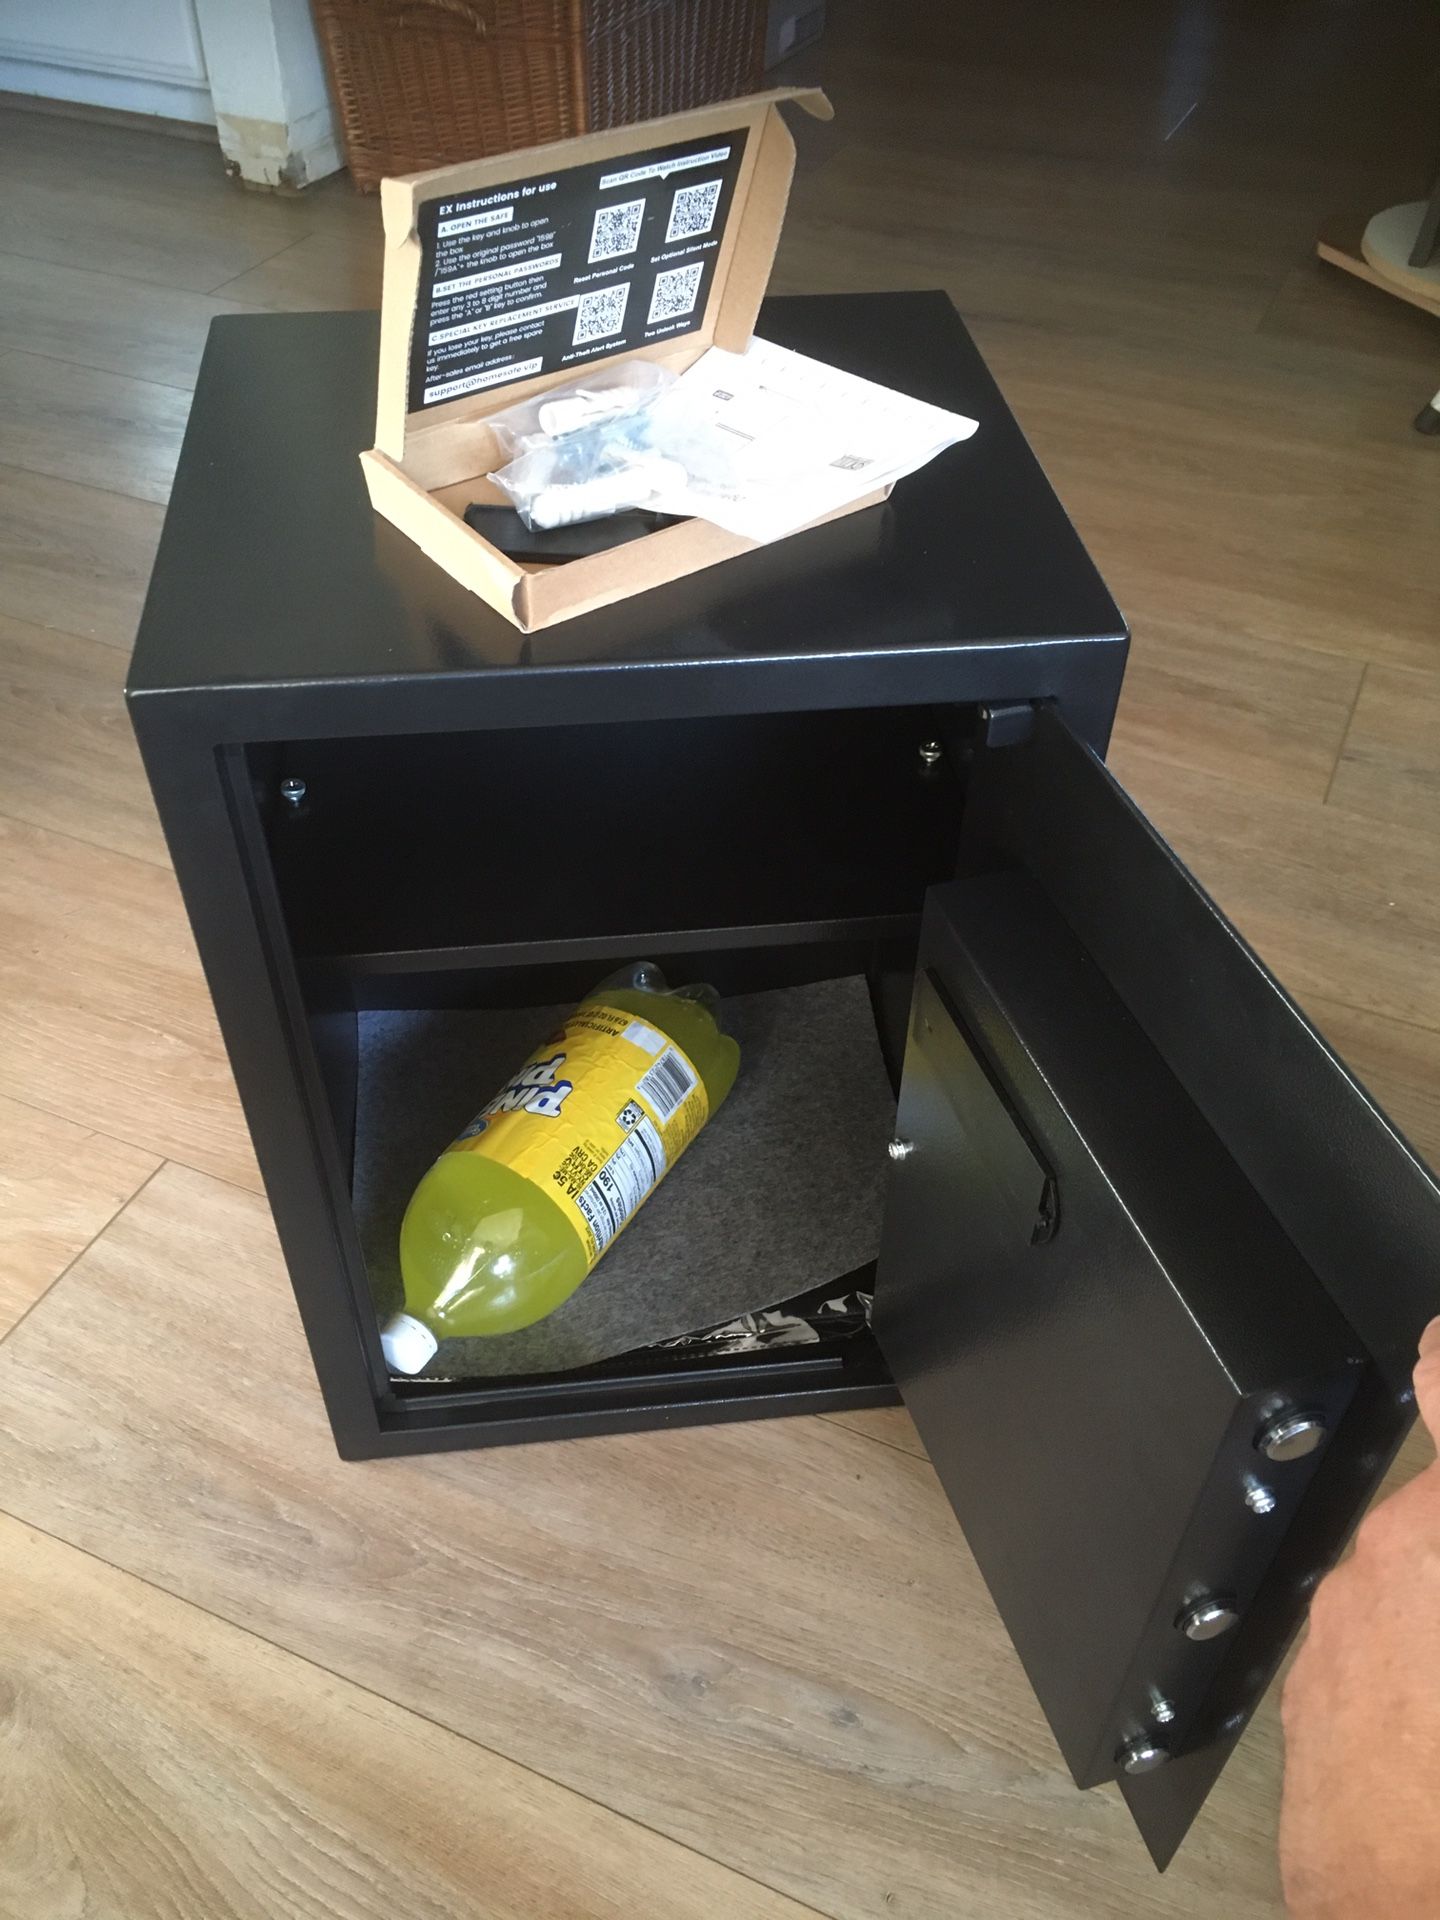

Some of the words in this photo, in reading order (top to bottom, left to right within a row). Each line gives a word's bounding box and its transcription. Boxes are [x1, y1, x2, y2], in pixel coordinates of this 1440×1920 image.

[601, 176, 616, 184] Scan
[629, 169, 646, 178] Code
[656, 162, 675, 172] Watch
[676, 154, 709, 167] Instruction
[710, 150, 727, 159] Video
[439, 204, 452, 216] EX
[455, 188, 519, 212] Instructions
[521, 184, 536, 197] for
[538, 182, 556, 193] use
[442, 238, 456, 248] Use
[458, 235, 470, 244] the
[472, 231, 484, 242] key
[486, 228, 500, 237] and
[502, 223, 520, 233] knob
[530, 217, 548, 228] open
[450, 221, 471, 230] OPEN
[474, 217, 487, 225] THE
[490, 212, 508, 221] SAFE
[435, 249, 447, 258] the
[449, 245, 463, 255] box
[442, 255, 457, 265] Use
[458, 252, 470, 261] the
[472, 245, 498, 260] original
[500, 236, 535, 252] password
[466, 259, 478, 268] the
[480, 254, 497, 264] knob
[507, 247, 526, 259] open
[527, 244, 539, 253] the
[540, 241, 553, 250] box
[650, 254, 660, 263] Set
[660, 248, 685, 261] Optional
[685, 243, 702, 253] Silent
[702, 239, 718, 248] Mode
[458, 279, 472, 288] THE
[474, 269, 511, 284] PERSONAL
[514, 258, 558, 274] PASSWORDS
[573, 273, 591, 283] Reset
[591, 266, 618, 278] Personal
[618, 262, 634, 271] Code
[430, 306, 448, 317] enter
[450, 303, 464, 313] any
[487, 292, 503, 304] digit
[504, 285, 531, 298] number
[533, 281, 547, 291] and
[431, 298, 450, 309] Press
[452, 294, 463, 303] the
[465, 291, 477, 300] red
[478, 284, 503, 298] setting
[504, 278, 526, 290] button
[528, 274, 544, 284] then
[429, 316, 449, 327] press
[451, 311, 463, 320] the
[493, 300, 505, 310] key
[433, 347, 446, 356] you
[448, 341, 462, 351] lose
[463, 338, 478, 348] your
[494, 327, 517, 340] please
[518, 320, 544, 332] contact
[644, 330, 655, 338] Two
[656, 324, 674, 334] Unlock
[675, 319, 691, 329] Ways
[436, 345, 479, 363] immediately
[489, 339, 501, 349] get
[508, 334, 522, 342] free
[523, 329, 542, 339] spare
[572, 1146, 587, 1162] CRV
[587, 1159, 597, 1172] CA
[566, 1183, 578, 1199] IA
[598, 1169, 613, 1192] 190
[577, 1195, 594, 1221] Facts
